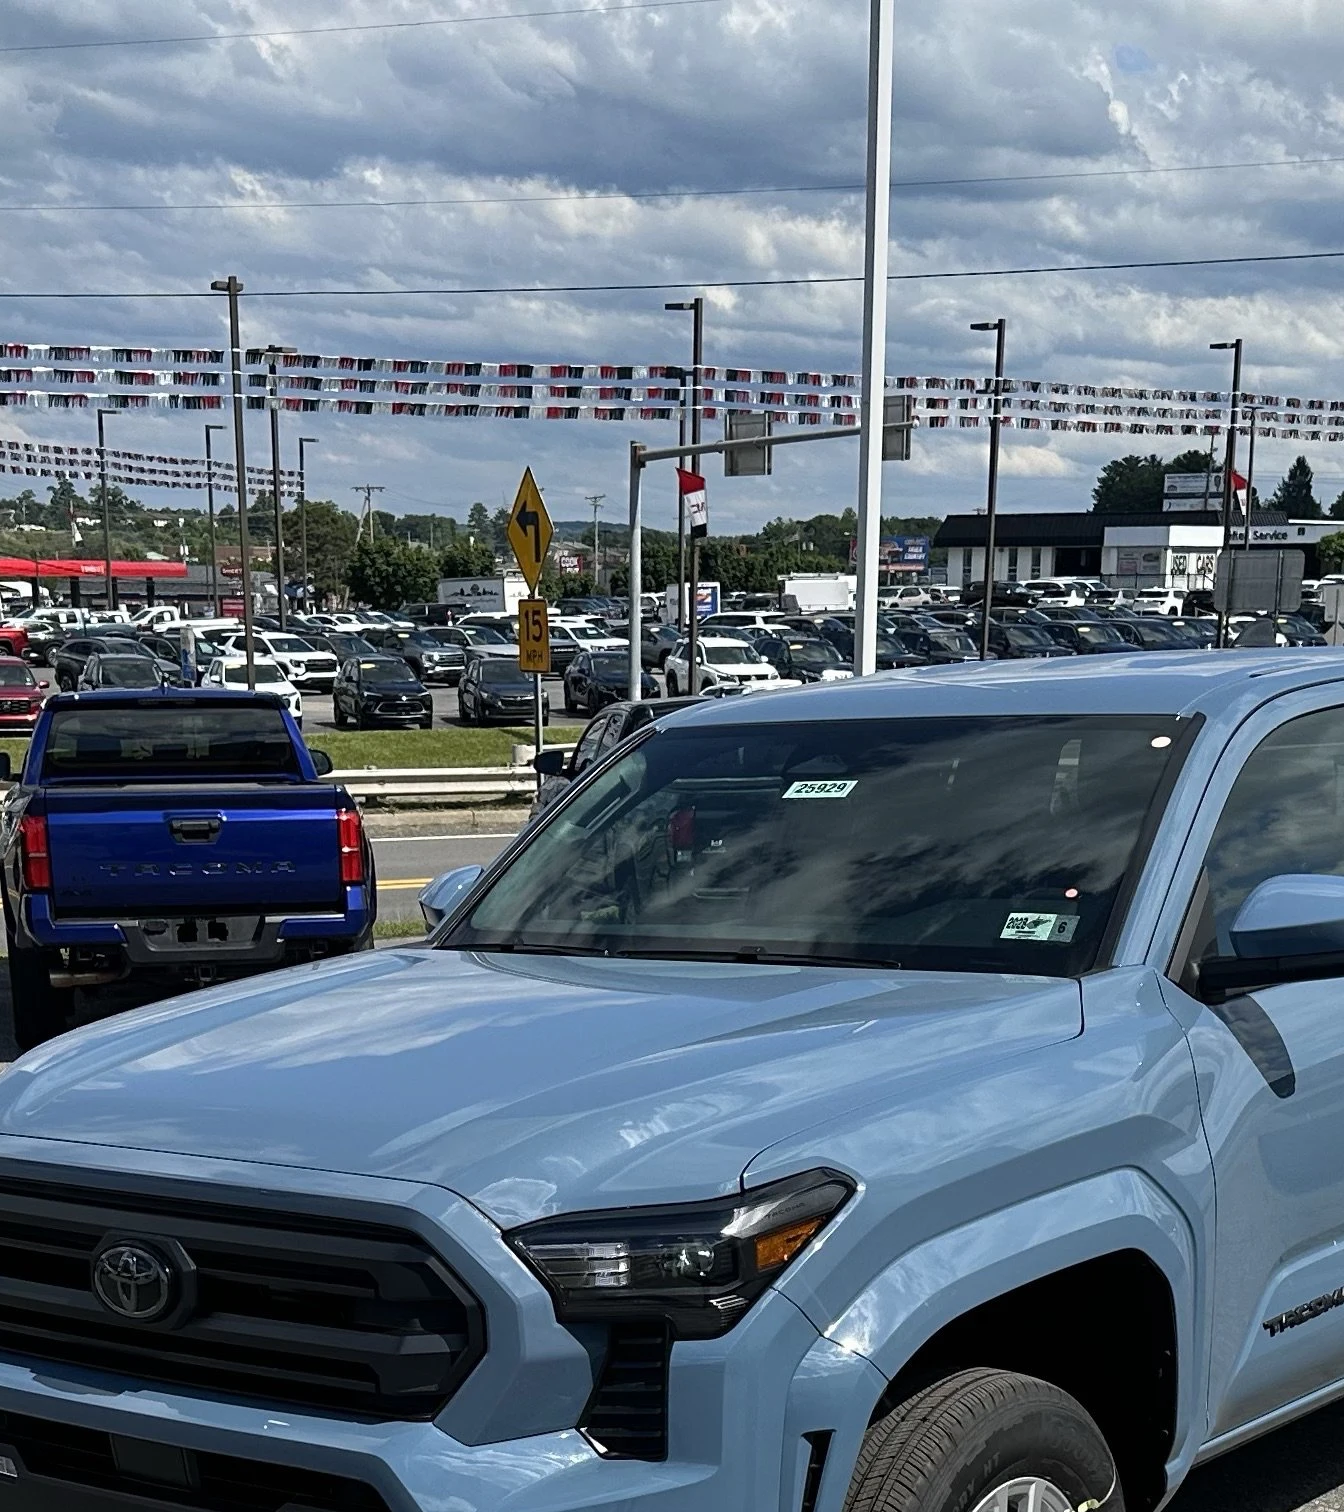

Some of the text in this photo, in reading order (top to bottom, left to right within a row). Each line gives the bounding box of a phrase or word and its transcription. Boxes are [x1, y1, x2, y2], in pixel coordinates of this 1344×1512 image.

[1253, 529, 1288, 540] Service
[524, 609, 543, 643] 15
[525, 650, 543, 665] MPH
[794, 782, 848, 794] 25929
[99, 860, 296, 877] TACOMA
[1057, 921, 1068, 934] 6
